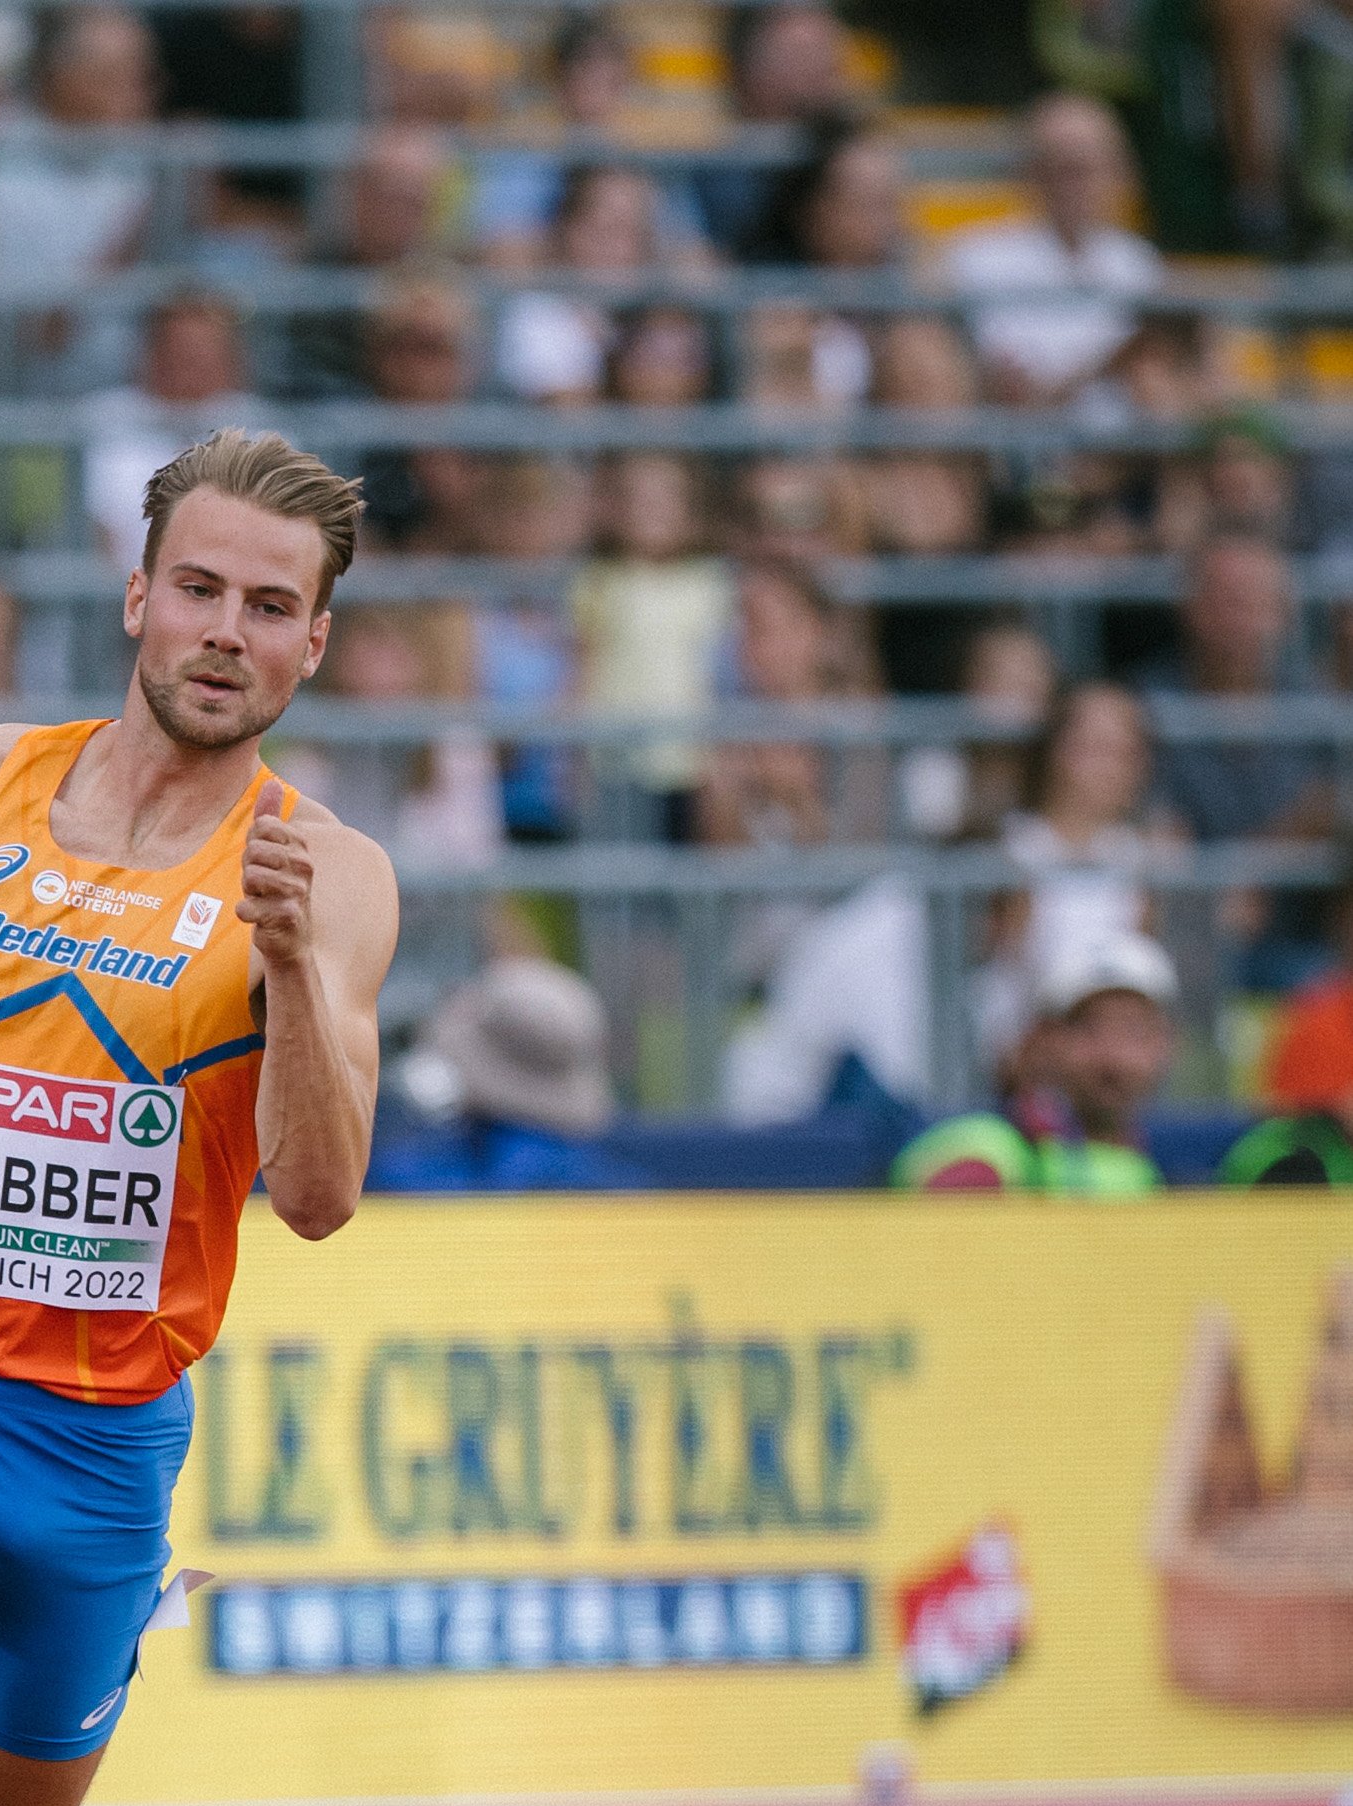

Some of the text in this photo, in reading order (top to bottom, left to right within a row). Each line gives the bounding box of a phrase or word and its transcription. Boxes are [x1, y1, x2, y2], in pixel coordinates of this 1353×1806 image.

[63, 892, 126, 916] LOTERIJ
[68, 880, 163, 910] NEDERLANDSE
[64, 1269, 145, 1299] 2022
[204, 1342, 324, 1542] LE
